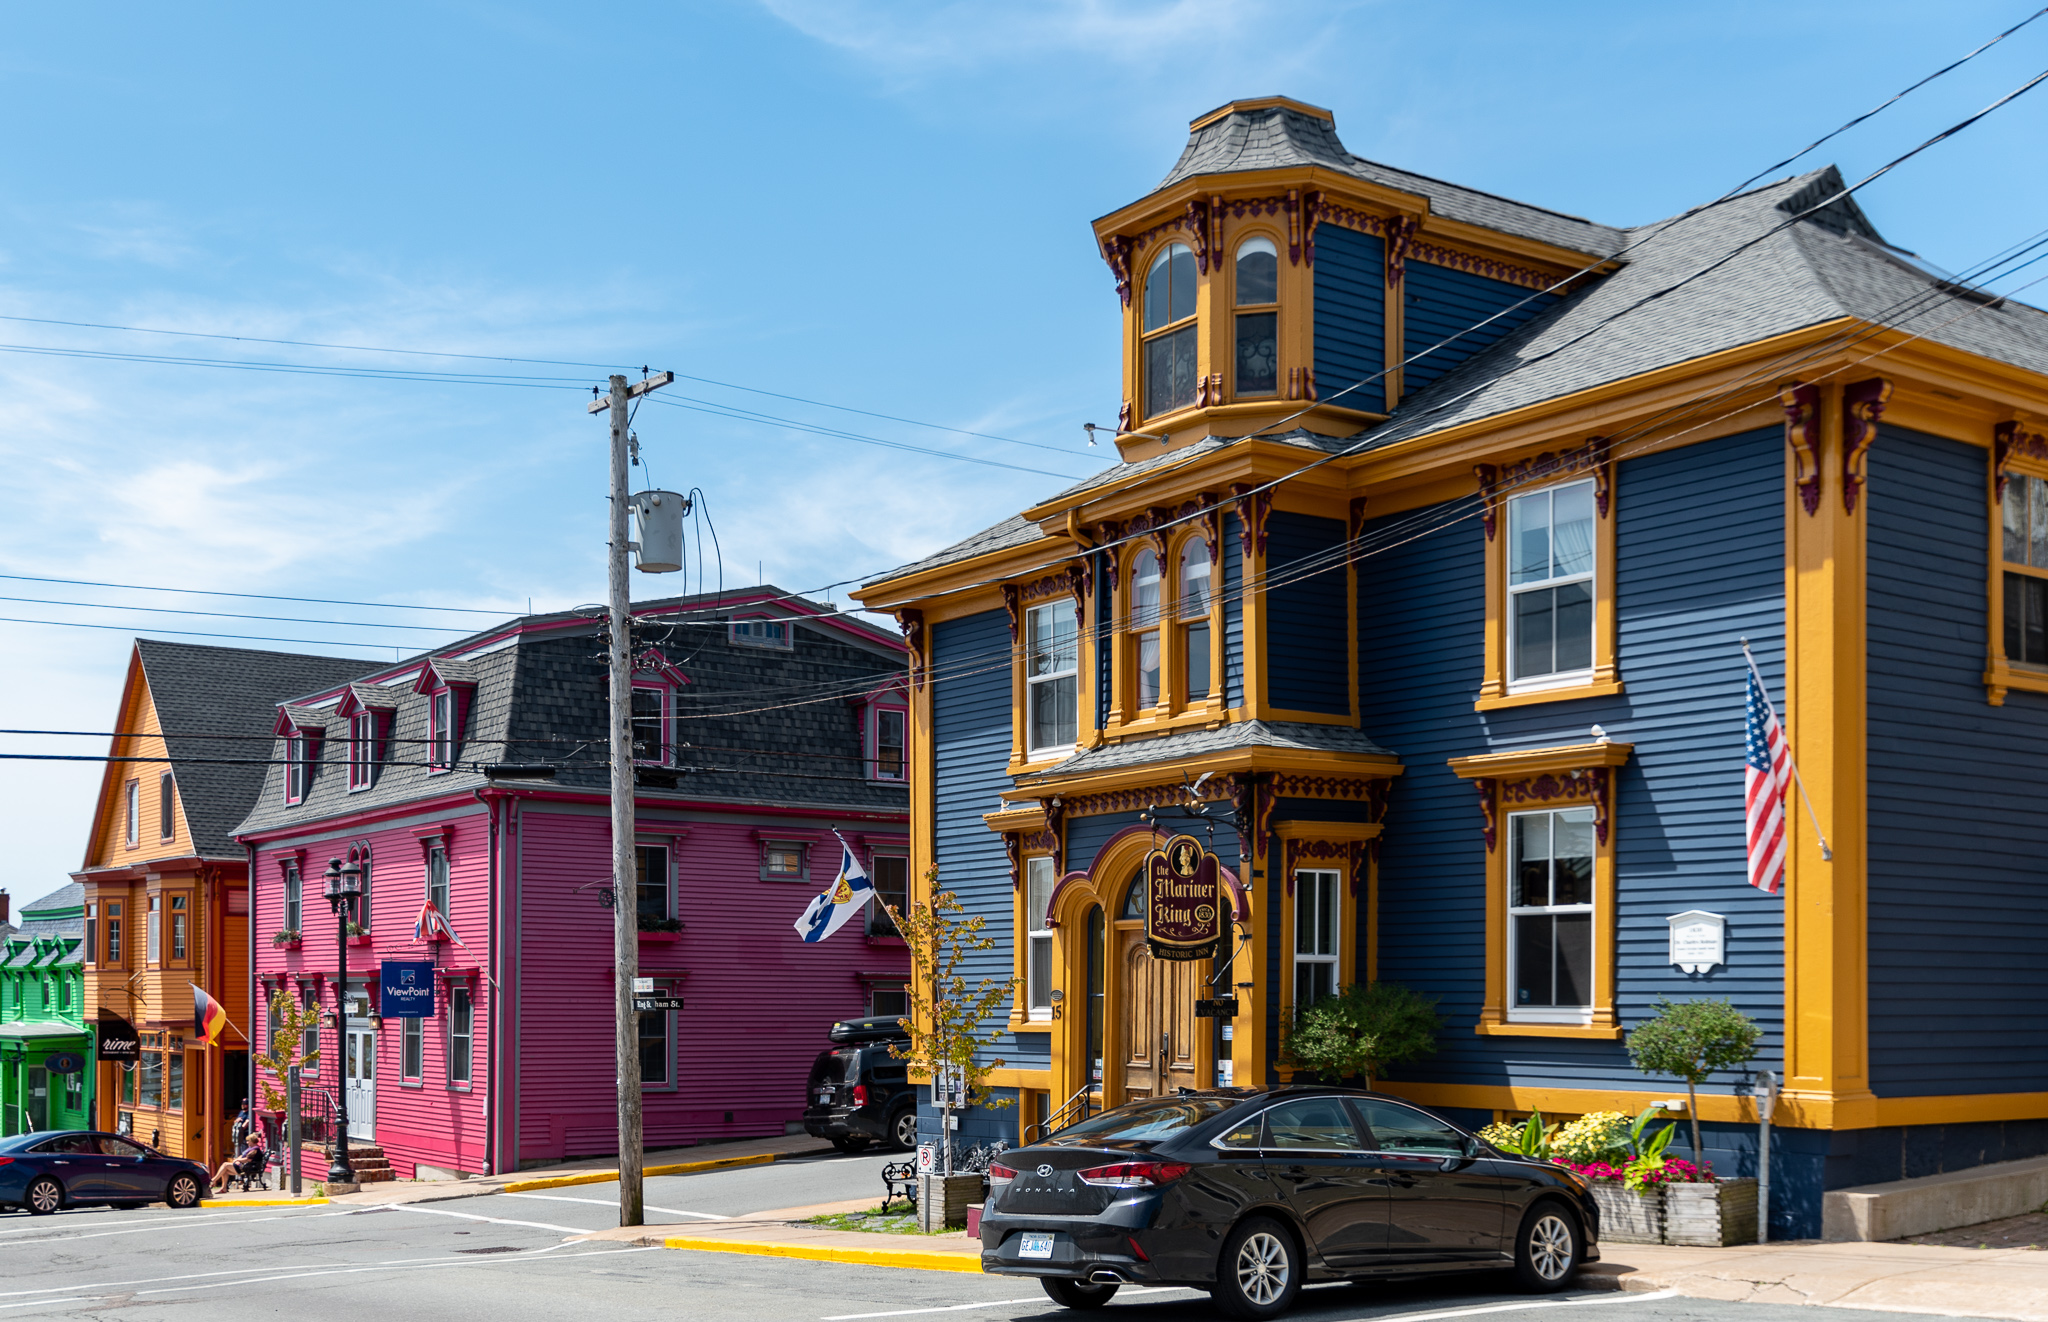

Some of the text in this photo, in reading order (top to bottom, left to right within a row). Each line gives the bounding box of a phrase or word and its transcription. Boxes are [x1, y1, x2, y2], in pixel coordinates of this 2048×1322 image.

[1156, 865, 1169, 876] the
[1155, 879, 1214, 901] Mariner
[1155, 904, 1191, 926] King
[1159, 947, 1209, 958] HISTORIC INN
[386, 986, 430, 996] ViewPoint
[1052, 1004, 1062, 1020] 15
[1200, 1008, 1236, 1016] VACANCY
[102, 1038, 136, 1050] rime
[1022, 1240, 1052, 1252] GEJ 640
